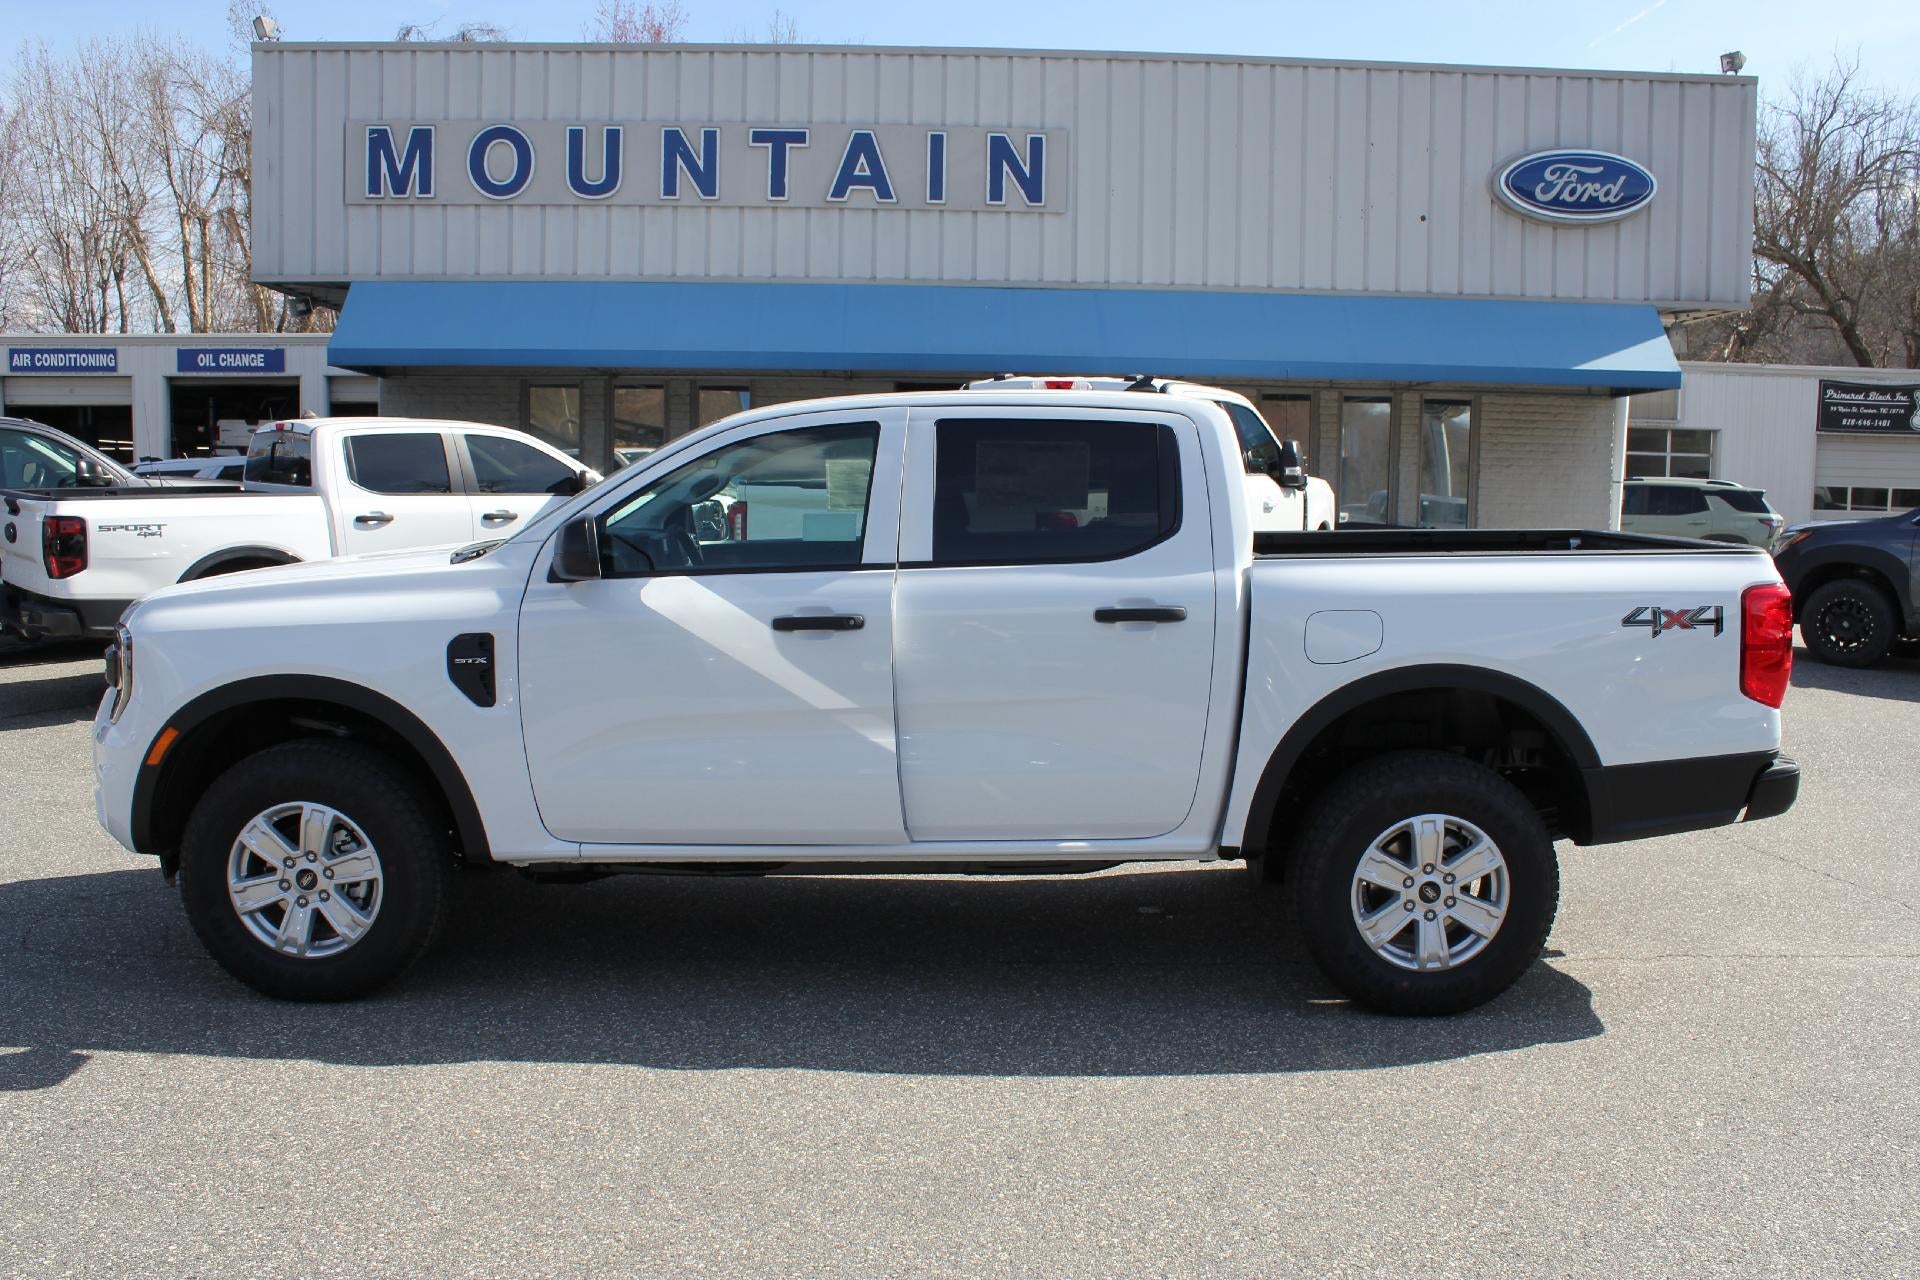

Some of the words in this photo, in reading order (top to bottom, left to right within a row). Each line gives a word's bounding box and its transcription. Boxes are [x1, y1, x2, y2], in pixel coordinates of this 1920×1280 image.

[364, 124, 1047, 206] MOUNTAIN
[1534, 163, 1627, 204] Ford
[12, 353, 31, 367] AIR
[34, 353, 116, 367] CONDITIONING
[197, 353, 216, 367] OIL
[219, 353, 265, 367] CHANGE
[1867, 391, 1892, 401] Black
[98, 524, 168, 532] SPORT
